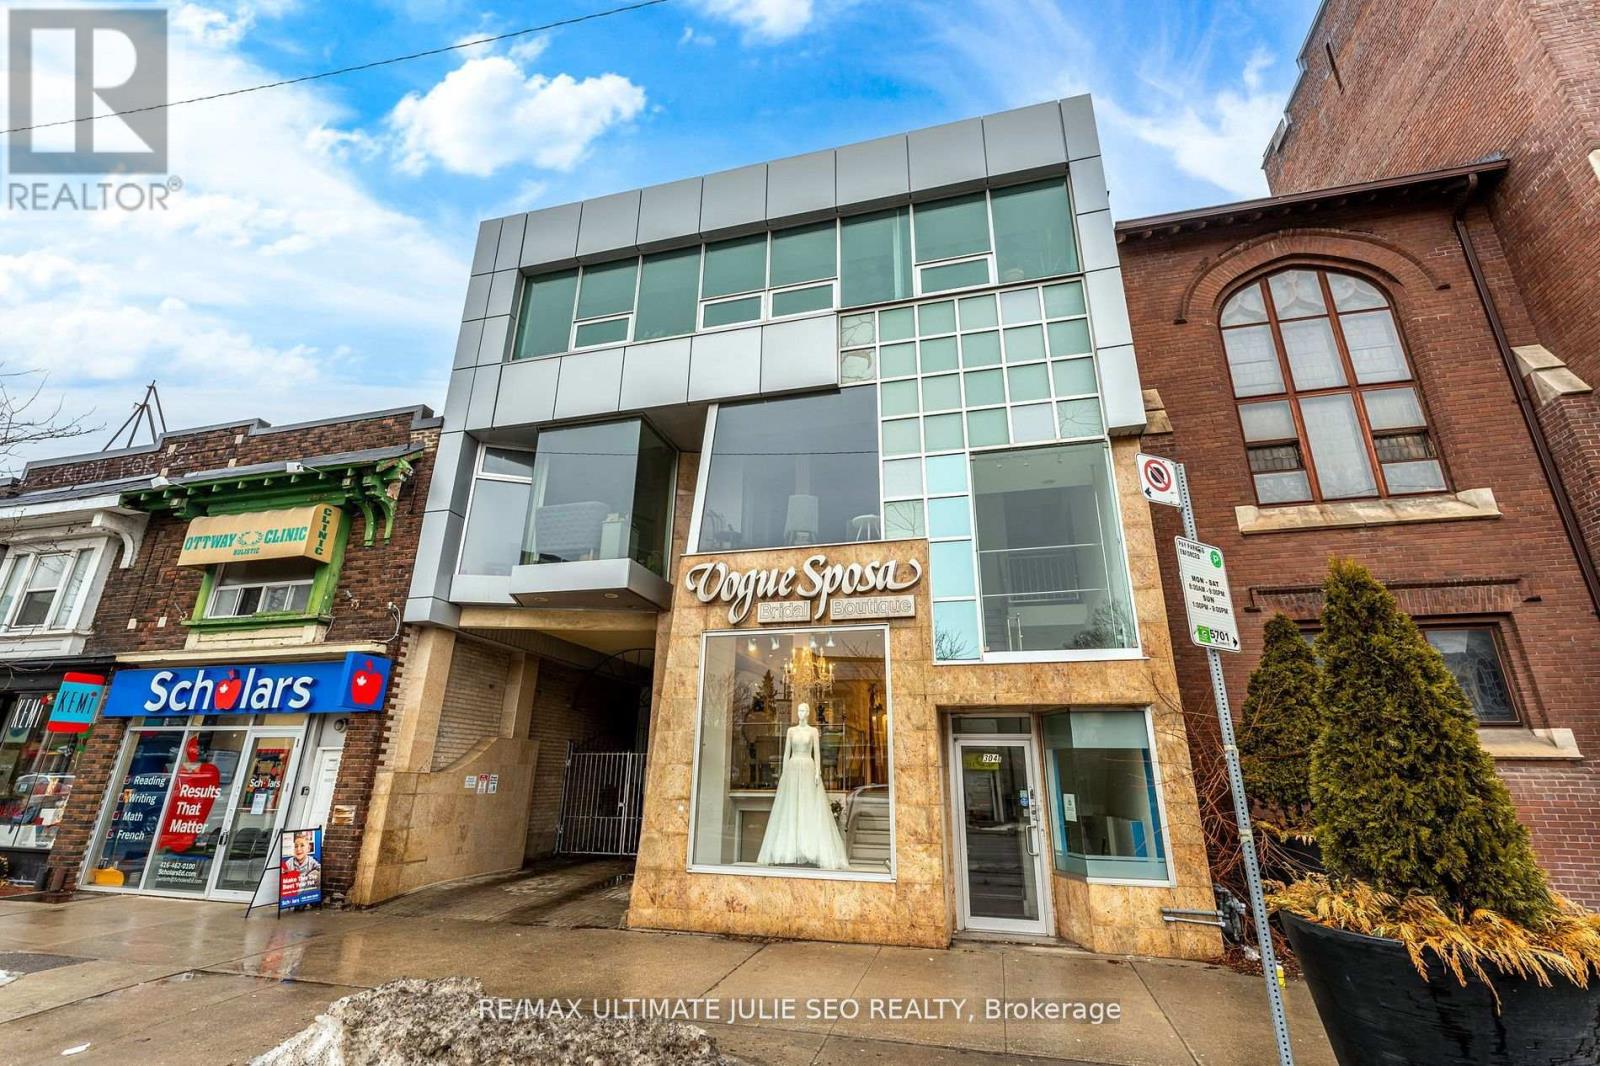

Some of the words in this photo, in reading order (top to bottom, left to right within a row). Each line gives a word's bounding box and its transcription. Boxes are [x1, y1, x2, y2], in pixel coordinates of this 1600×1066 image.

[315, 507, 333, 556] CLINIC
[184, 533, 237, 551] OTTWAY
[263, 526, 308, 545] CLINIC
[232, 547, 260, 556] HOLISTIC
[1191, 575, 1204, 583] MON
[685, 561, 797, 625] Vogue
[795, 554, 923, 621] Sposa
[1203, 595, 1215, 603] SUN
[759, 602, 809, 619] Bridal
[832, 598, 912, 618] Boutique
[1210, 629, 1229, 641] 5701
[133, 776, 167, 788] Reading
[179, 784, 222, 799] Results
[129, 793, 157, 805] Writing
[176, 802, 202, 816] That
[122, 812, 143, 822] Math
[169, 819, 209, 834] Matter
[116, 830, 145, 841] French
